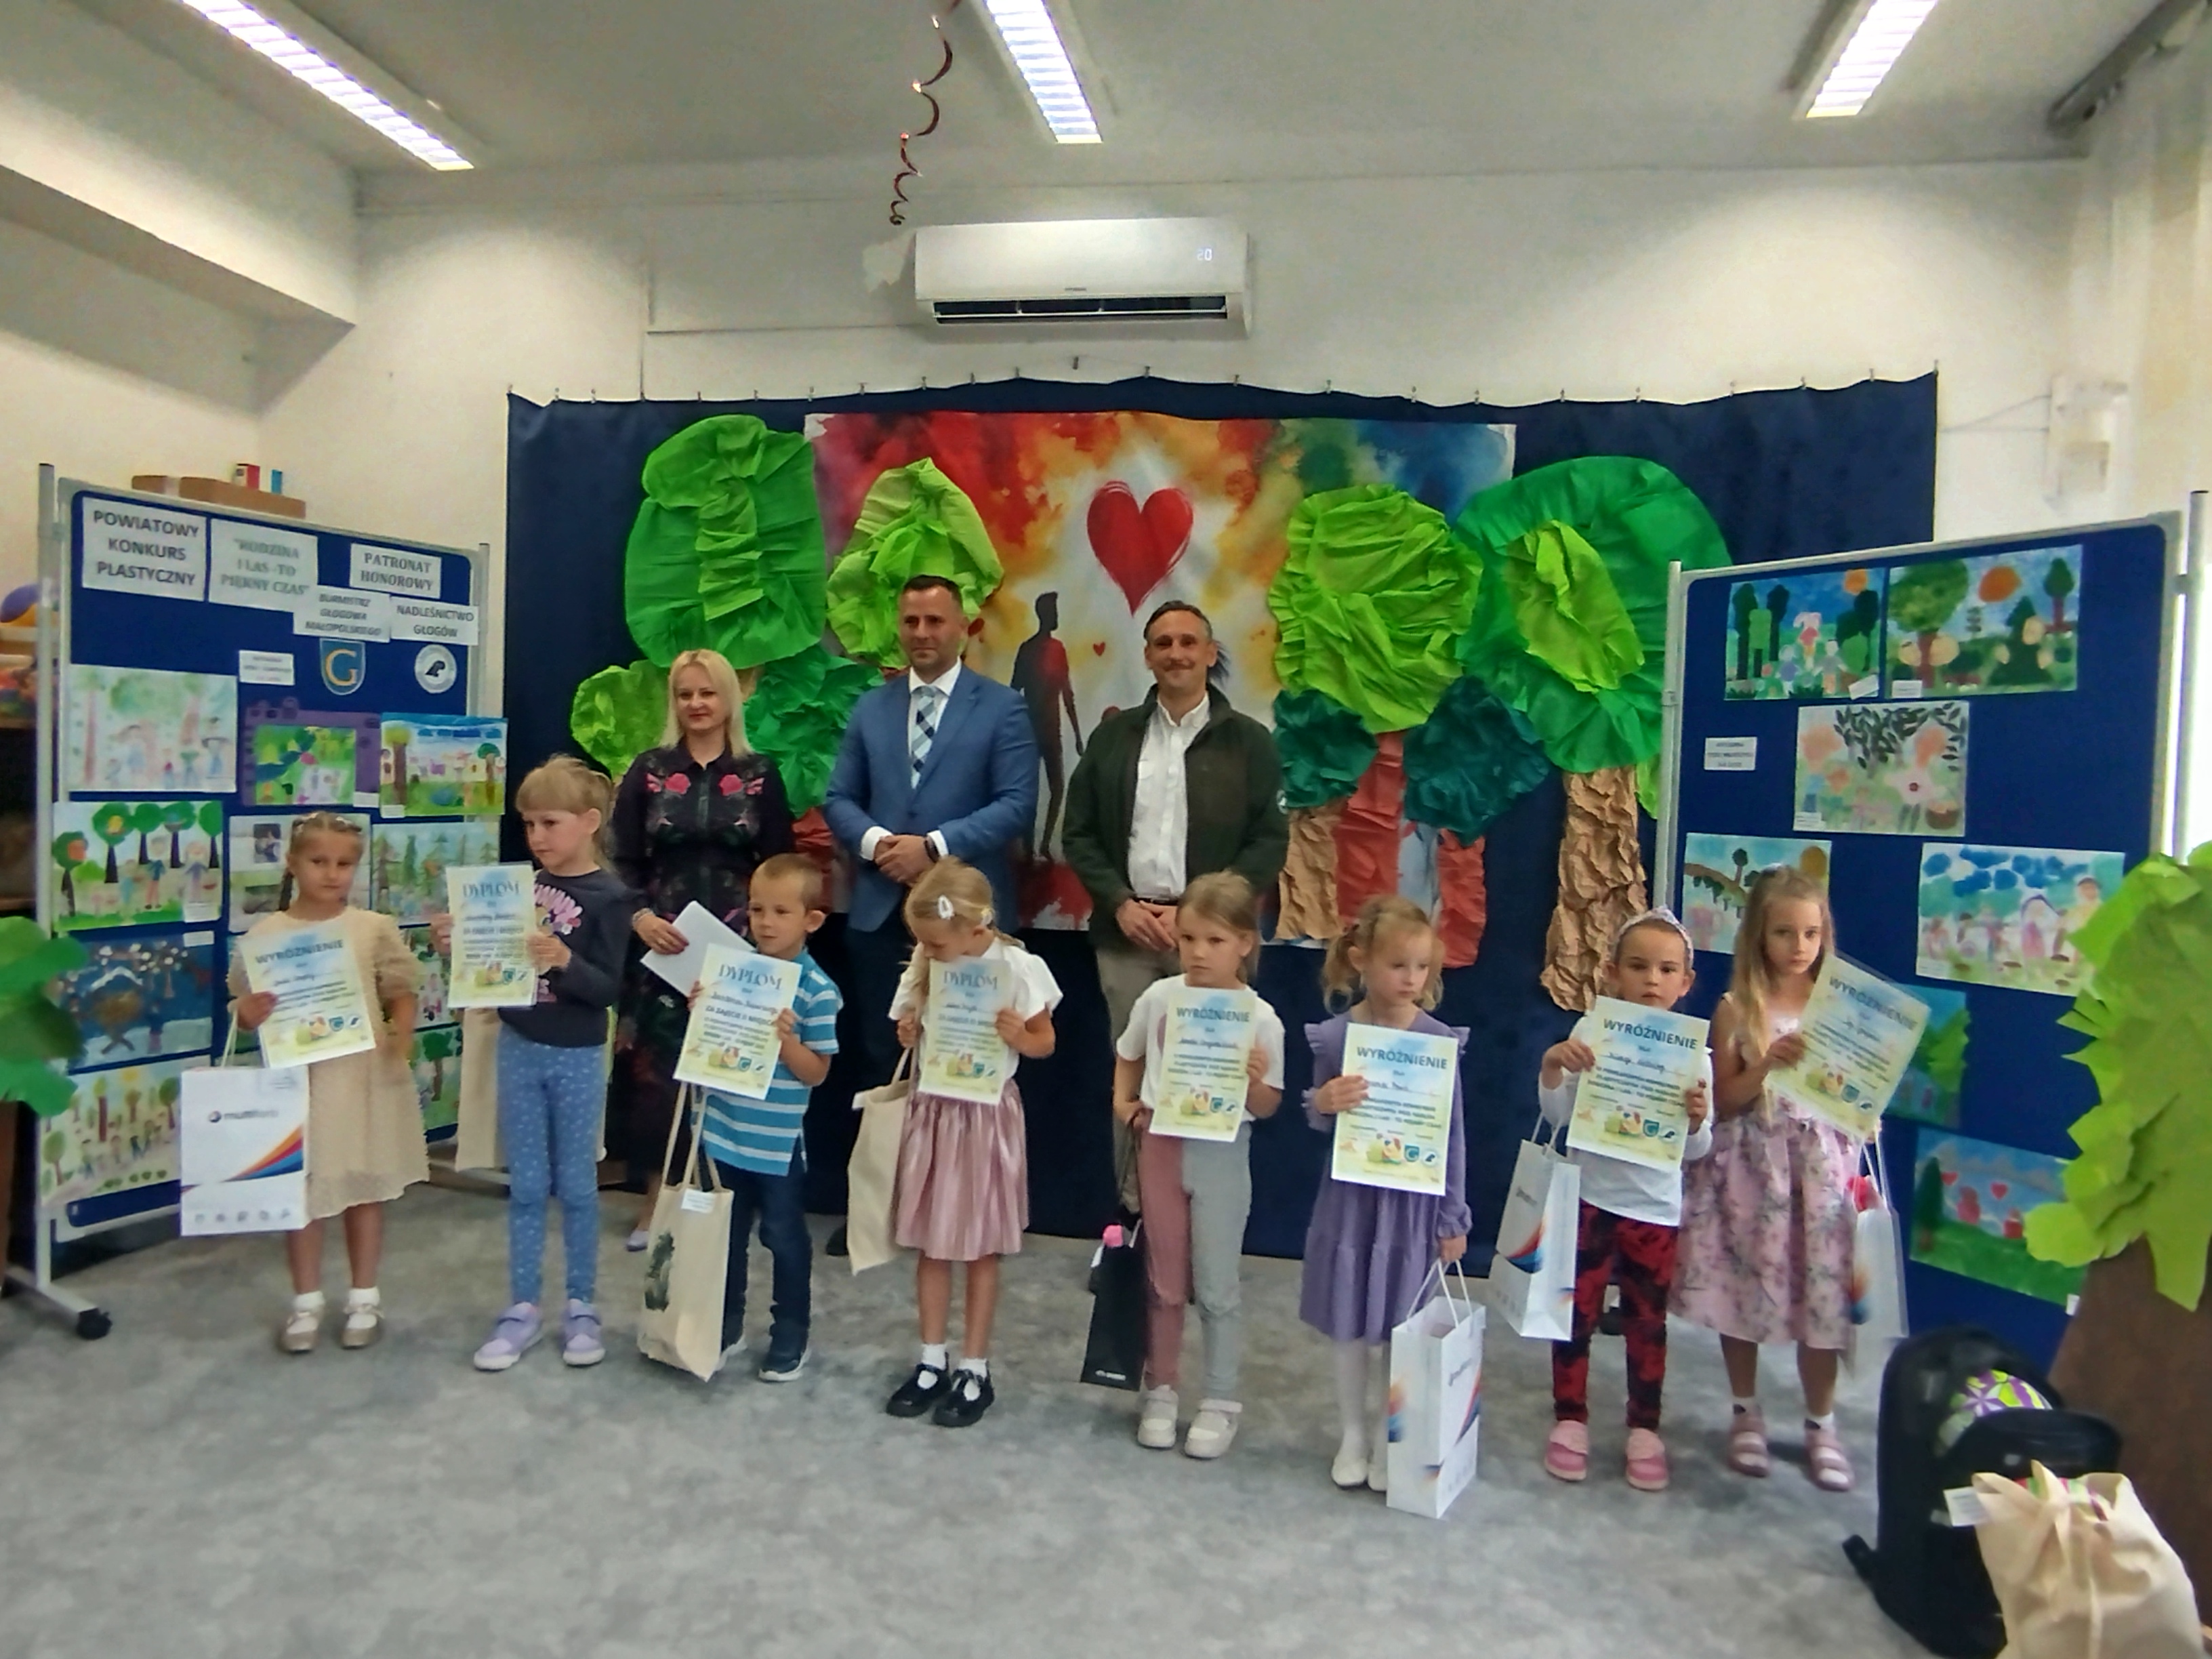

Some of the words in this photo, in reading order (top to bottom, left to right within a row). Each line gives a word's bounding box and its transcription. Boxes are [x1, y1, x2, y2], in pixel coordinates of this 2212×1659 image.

[1196, 248, 1213, 261] 20
[94, 510, 199, 537] POWIATOWY
[108, 538, 186, 560] KONKURS
[97, 561, 196, 586] PLASTYCZNY
[364, 552, 432, 574] PATRONAT
[361, 571, 434, 591] HONOROWY
[396, 605, 474, 621] NADLEŚNICTWO
[413, 624, 458, 637] GŁOGÓW
[325, 649, 358, 686] G
[463, 881, 519, 898] DYPLOM
[718, 964, 782, 990] DYPLOM
[943, 971, 998, 990] DYPLOM
[1176, 1006, 1250, 1022] WYRÓŻNIENIE
[1603, 1019, 1698, 1049] WYRÓŻNIENIE
[1357, 1046, 1448, 1069] WYRÓŻNIENIE
